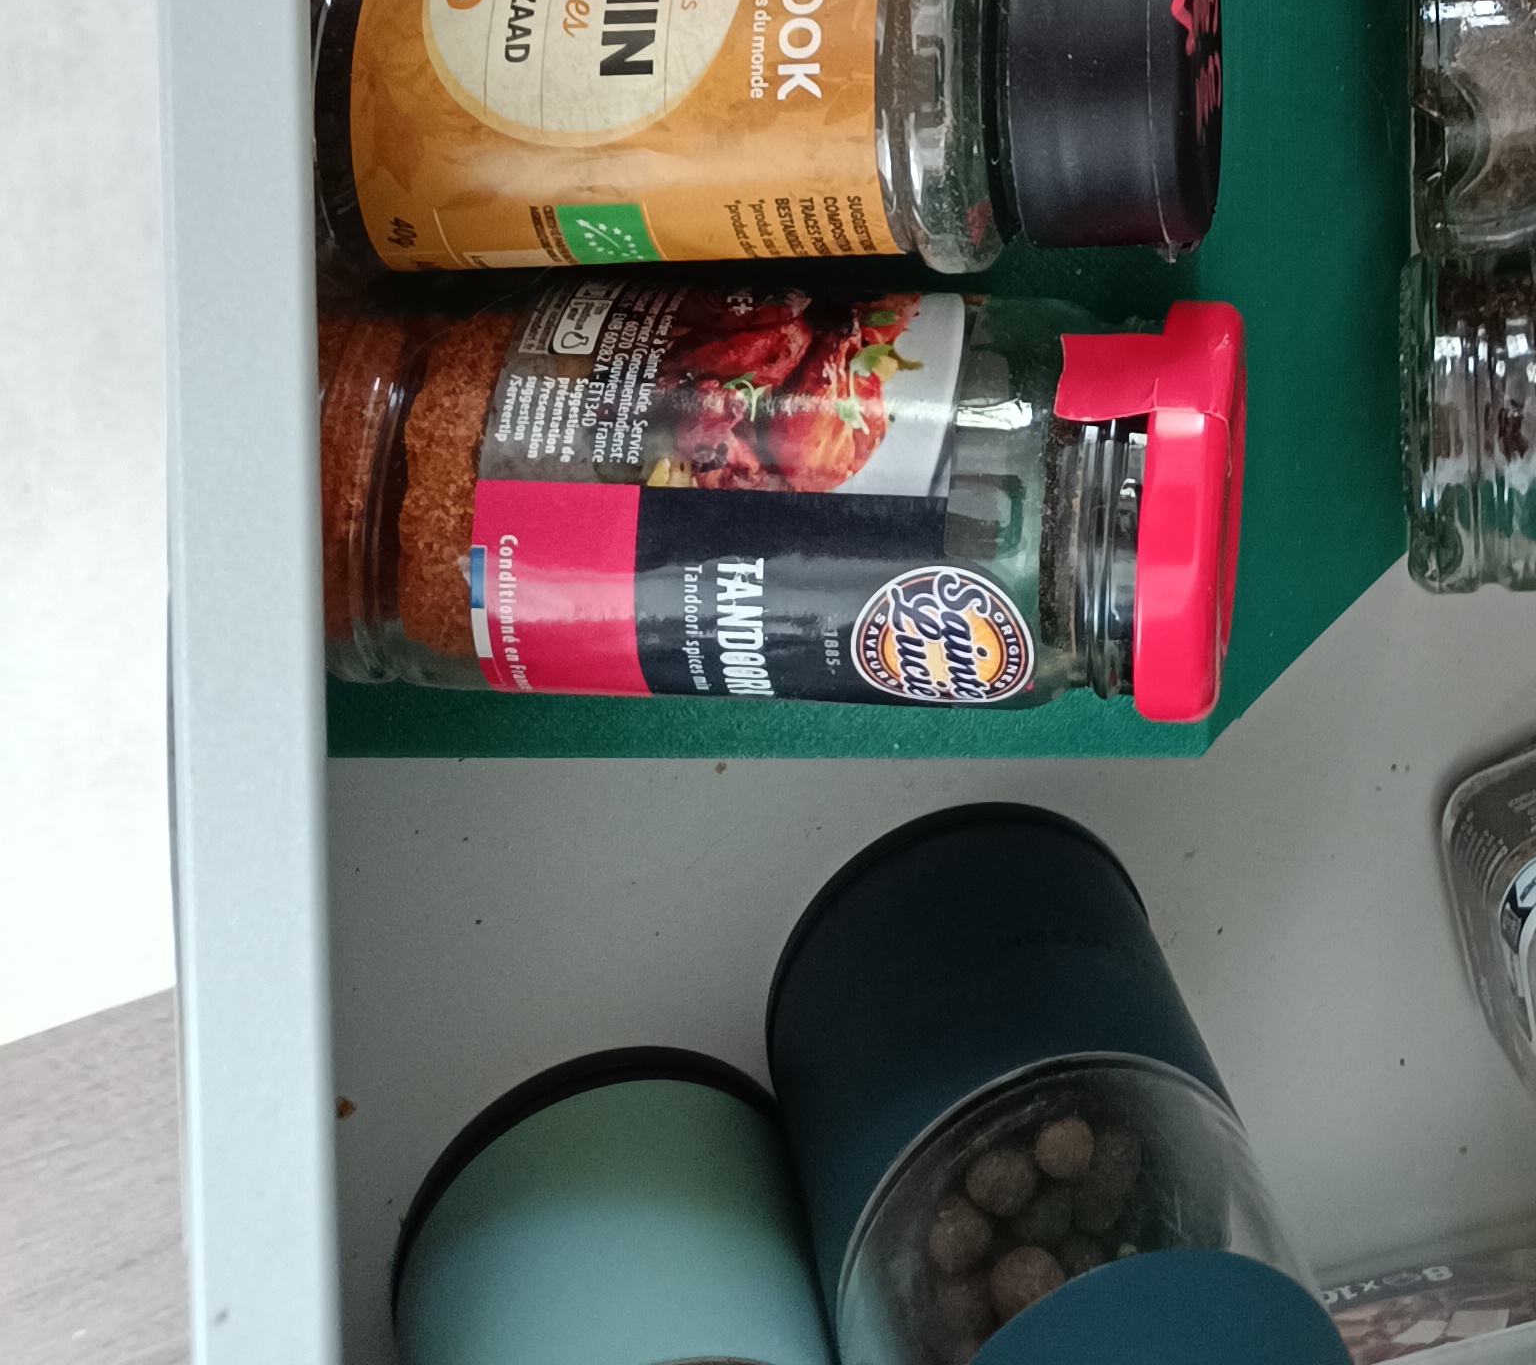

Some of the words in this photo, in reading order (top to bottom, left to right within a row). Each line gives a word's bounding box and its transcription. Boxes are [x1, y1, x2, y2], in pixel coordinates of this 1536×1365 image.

[752, 10, 770, 32] du
[749, 36, 768, 99] monde
[597, 332, 617, 361] 60282
[619, 321, 639, 349] 60270
[593, 364, 608, 372] A
[603, 353, 629, 404] Gouvieux
[644, 348, 665, 379] Sainte
[514, 376, 538, 440] suggestion
[527, 376, 556, 458] /Presentation
[545, 378, 570, 454] présentation
[564, 378, 588, 444] Suggestion
[582, 382, 604, 426] ET134D
[633, 383, 656, 415] Lucie,
[559, 447, 574, 462] de
[592, 422, 613, 463] France
[627, 419, 648, 464] Service
[498, 534, 520, 645] Conditionné
[682, 566, 703, 637] Tandoori
[715, 558, 776, 695] TANDOORI
[863, 612, 898, 688] SAVEURS
[887, 589, 941, 698] Lucie
[937, 573, 989, 699] Sainte
[991, 611, 1022, 692] ORIGINES
[505, 648, 522, 664] en
[681, 639, 708, 675] spices
